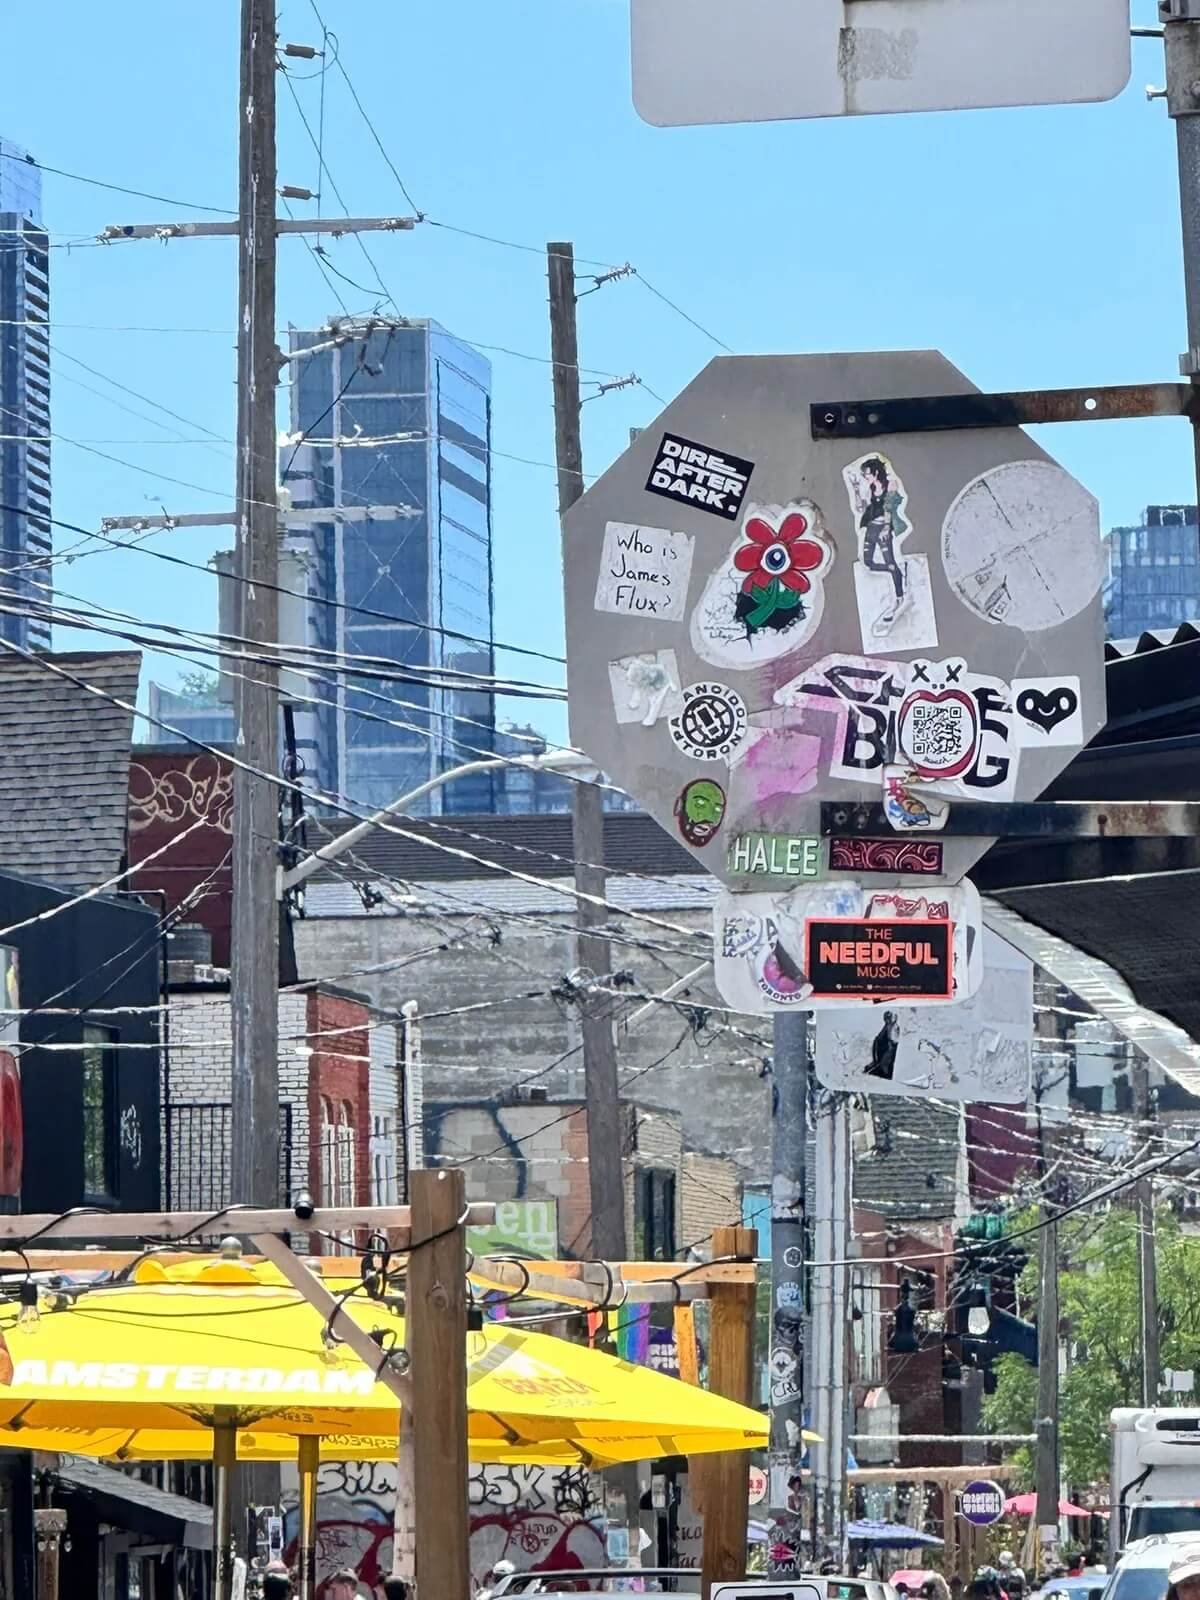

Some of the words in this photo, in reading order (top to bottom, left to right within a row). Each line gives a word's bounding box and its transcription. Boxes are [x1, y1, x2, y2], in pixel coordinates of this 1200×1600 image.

[662, 440, 737, 472] DIRE
[651, 471, 737, 513] DARK.
[656, 458, 748, 497] AFTER
[617, 530, 653, 554] Who
[662, 545, 678, 560] is
[610, 554, 671, 586] James
[615, 585, 672, 613] Flux?
[671, 684, 739, 741] PAANOID
[865, 928, 893, 940] THE
[820, 941, 939, 965] NEEDFUL
[856, 965, 901, 978] MUSIC
[11, 1359, 375, 1396] AMSTERDAM
